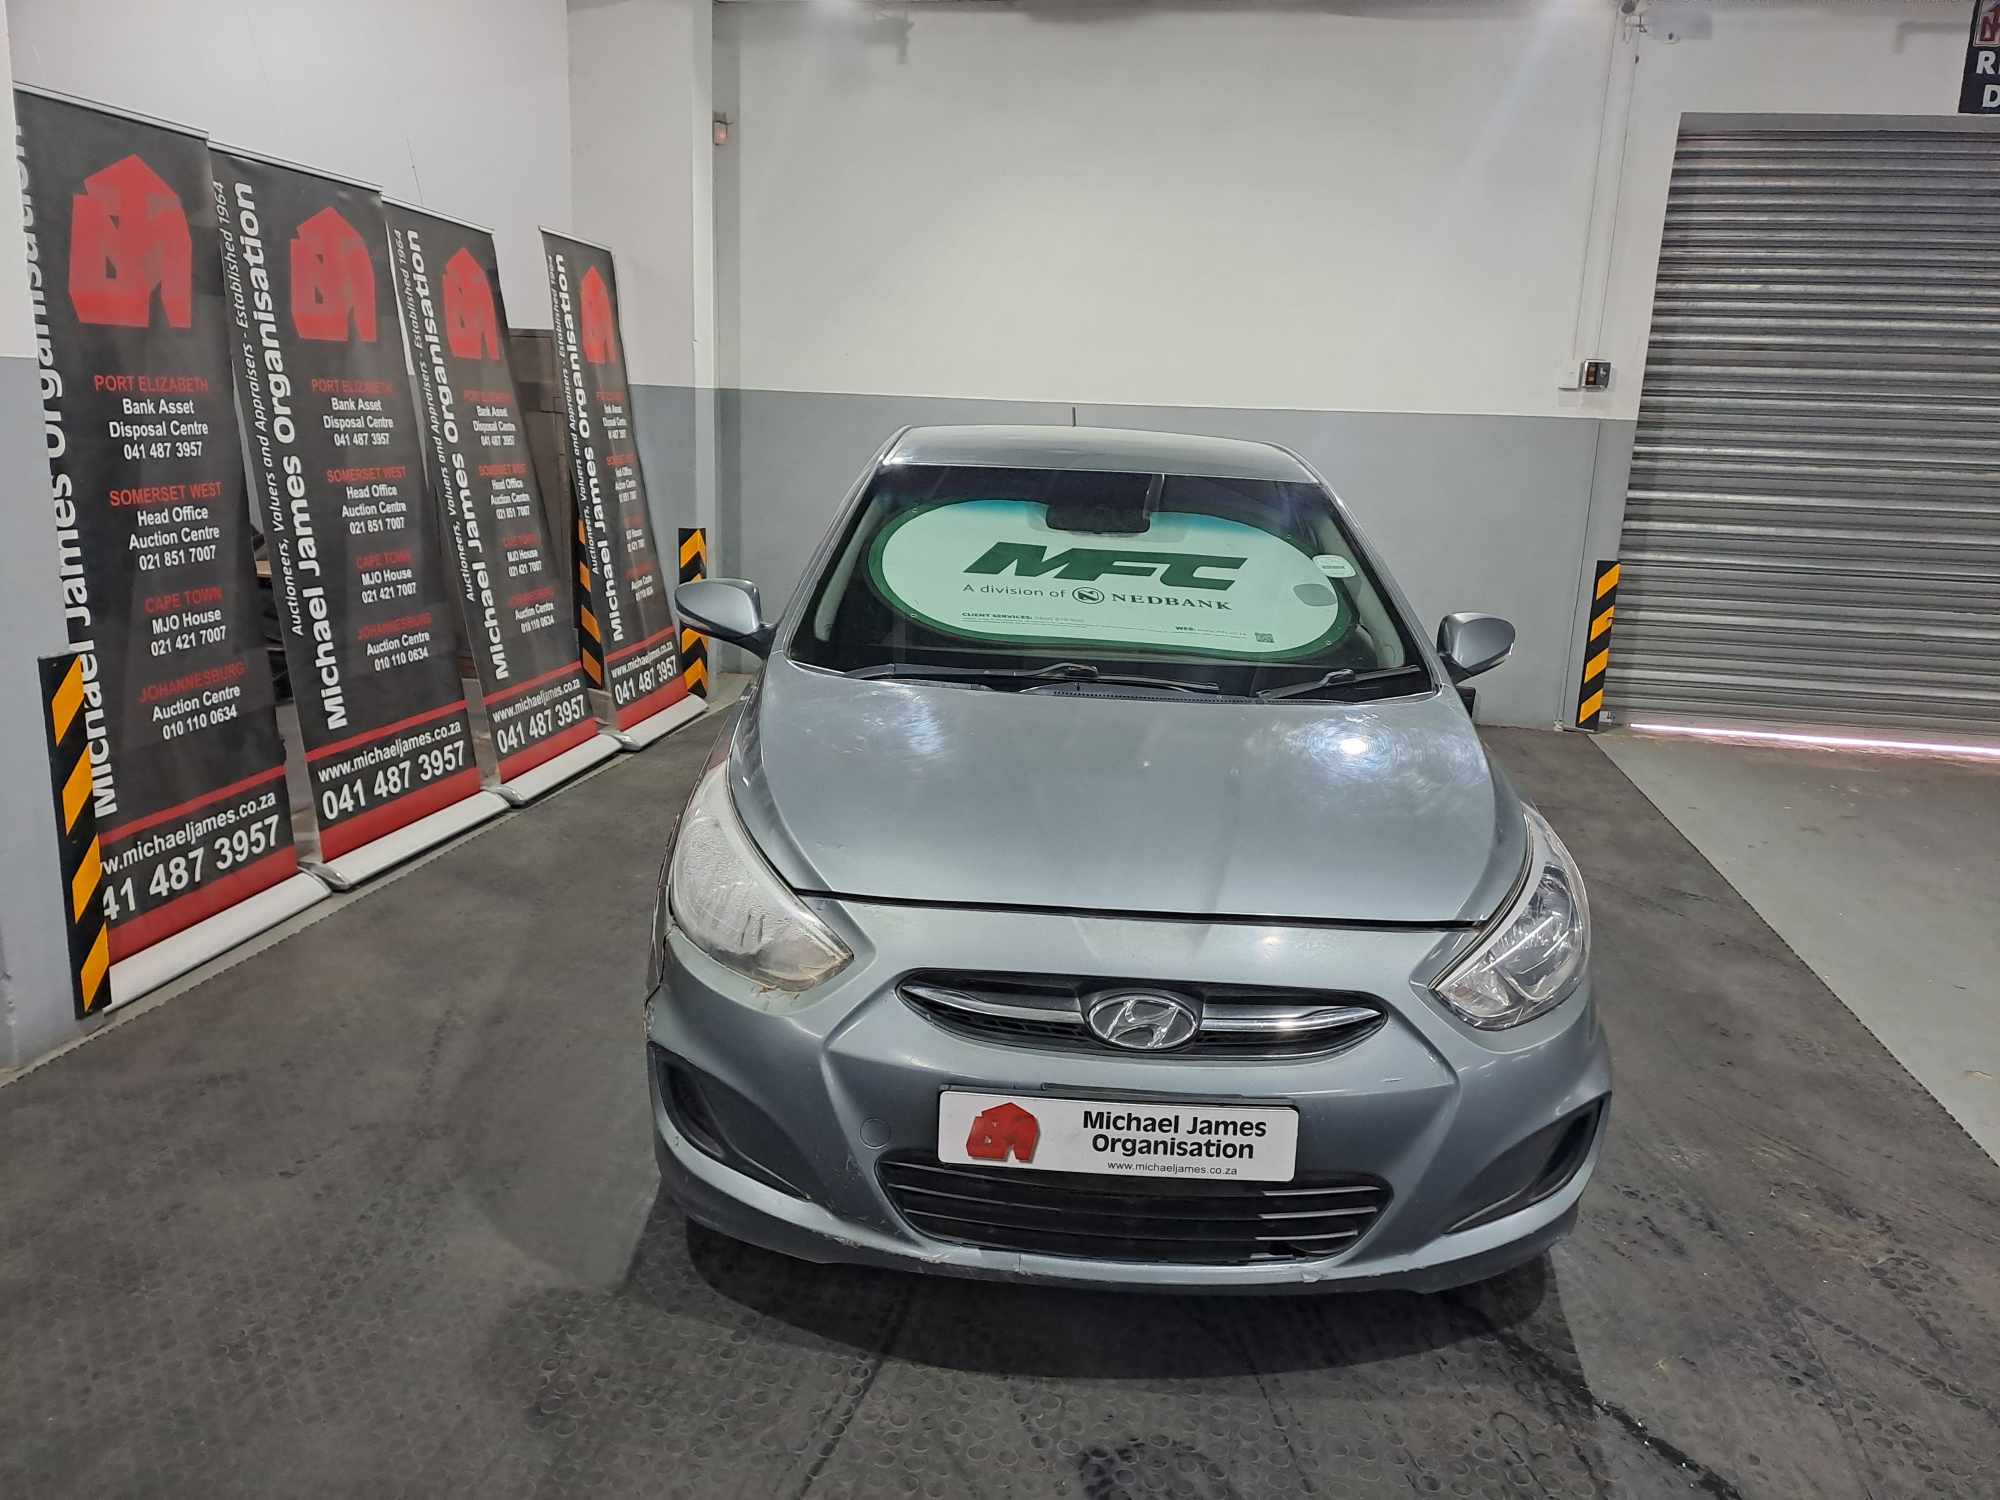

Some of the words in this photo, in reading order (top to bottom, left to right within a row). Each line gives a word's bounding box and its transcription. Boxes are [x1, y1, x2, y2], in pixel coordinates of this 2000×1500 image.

[1976, 50, 2000, 74] R
[212, 181, 229, 224] 1964
[220, 229, 248, 328] Established
[235, 182, 295, 443] Organisation
[407, 229, 458, 444] Organisation
[555, 254, 590, 440] Organisation
[94, 375, 134, 391] PORT
[139, 377, 208, 392] ELIZABETH
[243, 344, 268, 432] Appraisers
[122, 398, 155, 414] Bank
[158, 399, 194, 414] Asset
[331, 397, 356, 410] Bank
[358, 399, 382, 411] Asset
[109, 421, 166, 440] Disposal
[170, 420, 208, 436] Centre
[323, 415, 364, 430] Disposal
[366, 416, 394, 428] Centre
[124, 444, 145, 460] 041
[150, 443, 171, 457] 487
[176, 442, 202, 456] 3957
[256, 434, 273, 467] and
[334, 434, 350, 446] 041
[353, 434, 368, 446] 487
[371, 433, 390, 445] 3957
[110, 485, 185, 506] SOMERSET
[190, 482, 222, 498] WEST
[266, 471, 285, 532] Valuers
[346, 486, 370, 500] Head
[371, 484, 398, 497] Office
[439, 468, 456, 516] Valuers
[452, 452, 482, 553] James
[584, 447, 606, 533] James
[137, 511, 169, 526] Head
[172, 506, 208, 522] Office
[282, 455, 321, 576] James
[342, 503, 377, 517] Auction
[379, 501, 407, 514] Centre
[129, 530, 178, 550] Auction
[181, 525, 219, 543] Centre
[350, 522, 365, 535] 021
[367, 520, 383, 533] 851
[385, 517, 404, 530] 7007
[51, 472, 90, 627] James
[139, 555, 160, 570] 021
[164, 551, 184, 567] 851
[189, 545, 216, 563] 7007
[362, 571, 382, 585] MJO
[383, 568, 412, 582] House
[963, 541, 1247, 591] MFC
[144, 594, 181, 613] CAPE
[184, 586, 222, 604] TOWN
[279, 539, 304, 635] Auctioneers,
[362, 591, 377, 604] 021
[379, 587, 395, 599] 421
[397, 582, 417, 597] 7007
[597, 540, 624, 642] Michael
[962, 584, 974, 593] A
[981, 584, 1043, 598] division
[1050, 588, 1065, 599] of
[1111, 593, 1233, 611] NEDBANK
[152, 617, 180, 634] MJO
[183, 609, 221, 627] House
[472, 562, 509, 680] Michael
[150, 641, 172, 656] 021
[175, 633, 196, 650] 421
[200, 626, 227, 644] 7007
[367, 638, 400, 656] Auction
[401, 631, 430, 647] Centre
[302, 587, 348, 730] Michael
[375, 657, 390, 671] 010
[392, 653, 406, 666] 110
[408, 647, 429, 663] 0634
[615, 682, 636, 706] 041
[638, 670, 656, 696] 487
[657, 655, 677, 683] 3957
[152, 698, 199, 722] Auction
[203, 686, 240, 706] Centre
[163, 721, 184, 739] 010
[187, 714, 207, 732] 110
[210, 704, 237, 724] 0634
[497, 721, 526, 754] 041
[529, 711, 552, 739] 487
[555, 694, 585, 726] 3957
[318, 720, 461, 783] www.michaeljames.co.za
[322, 779, 366, 820] 041
[374, 760, 411, 798] 487
[419, 741, 465, 781] 3957
[101, 792, 276, 875] w.michaeljames.co.za
[149, 847, 204, 897] 487
[214, 814, 280, 870] 3957
[1083, 1111, 1179, 1133] Michael
[1187, 1116, 1266, 1137] James
[1092, 1134, 1254, 1159] Organisation
[1107, 1161, 1238, 1175] www.michaeljames.co.za
